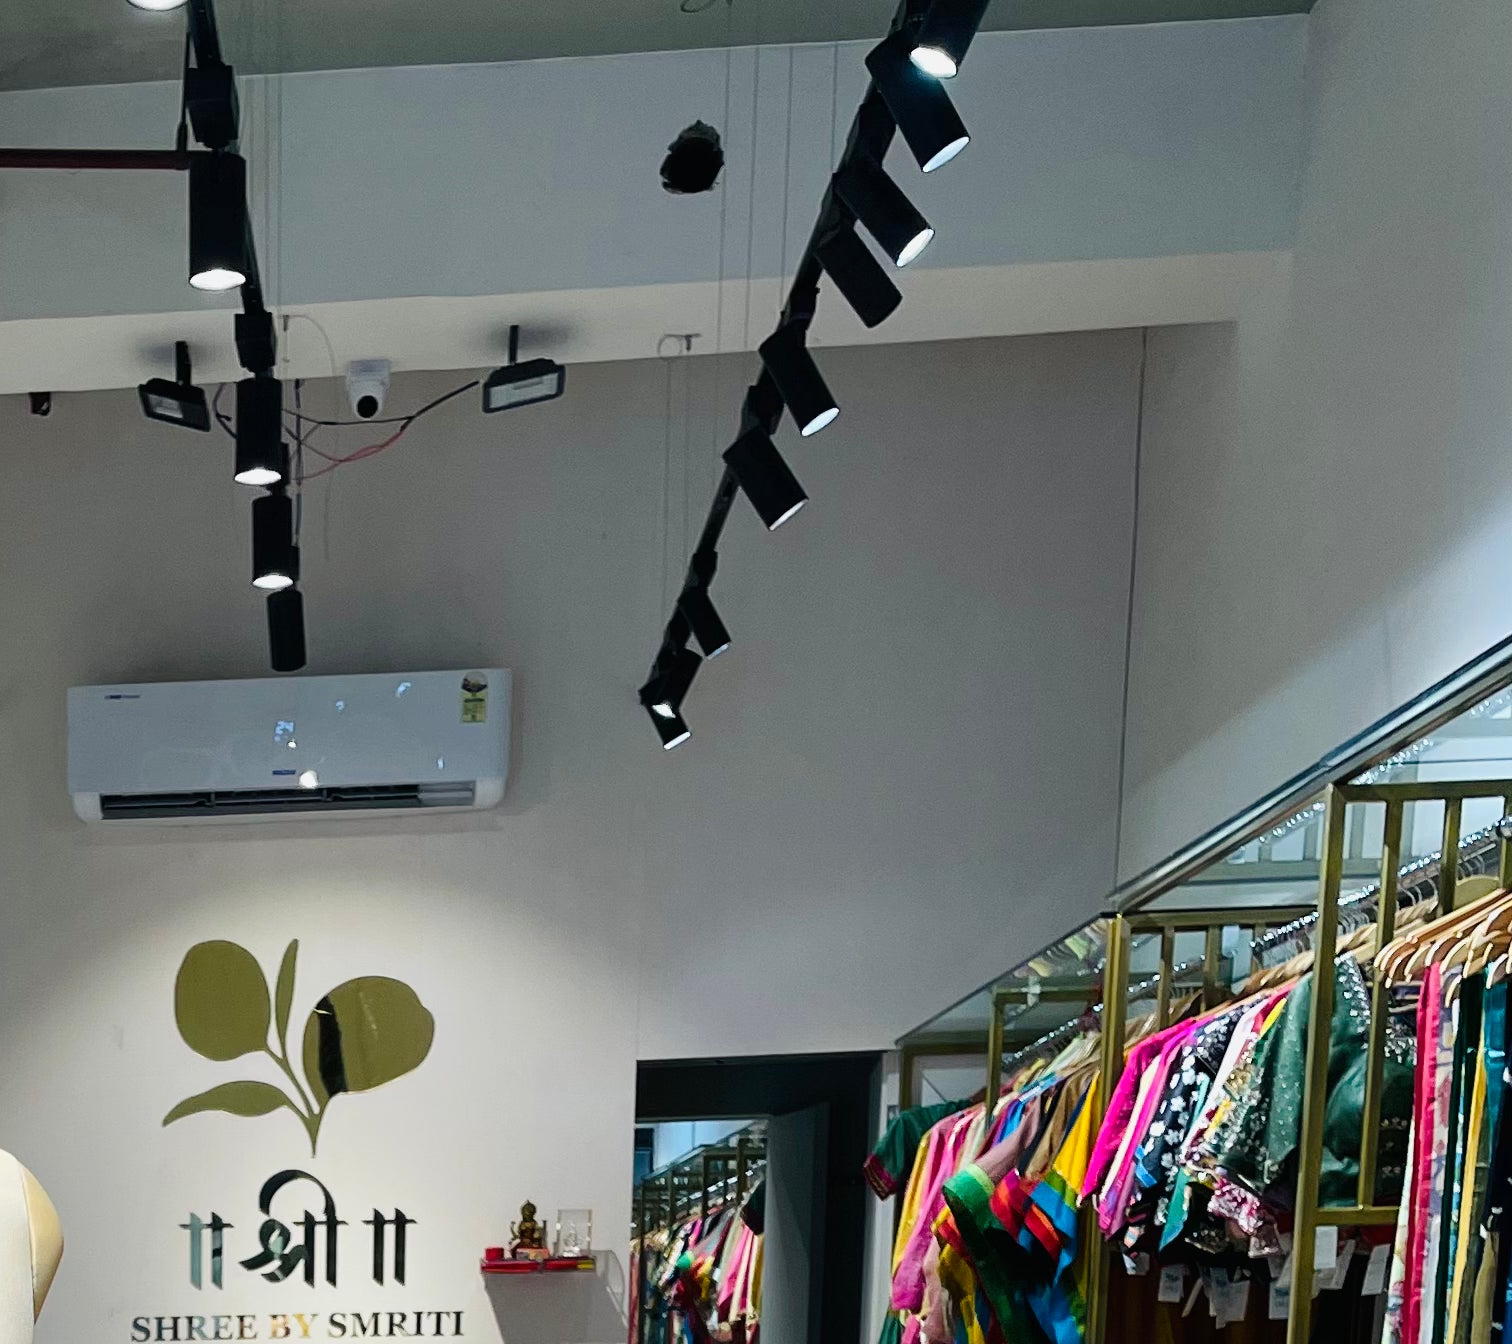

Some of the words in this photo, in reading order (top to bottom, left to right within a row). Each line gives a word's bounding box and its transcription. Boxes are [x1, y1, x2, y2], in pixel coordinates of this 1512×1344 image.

[239, 1169, 348, 1289] श्री
[131, 1314, 258, 1342] SHREE
[270, 1313, 318, 1338] BY
[329, 1311, 465, 1338] SMRITI
